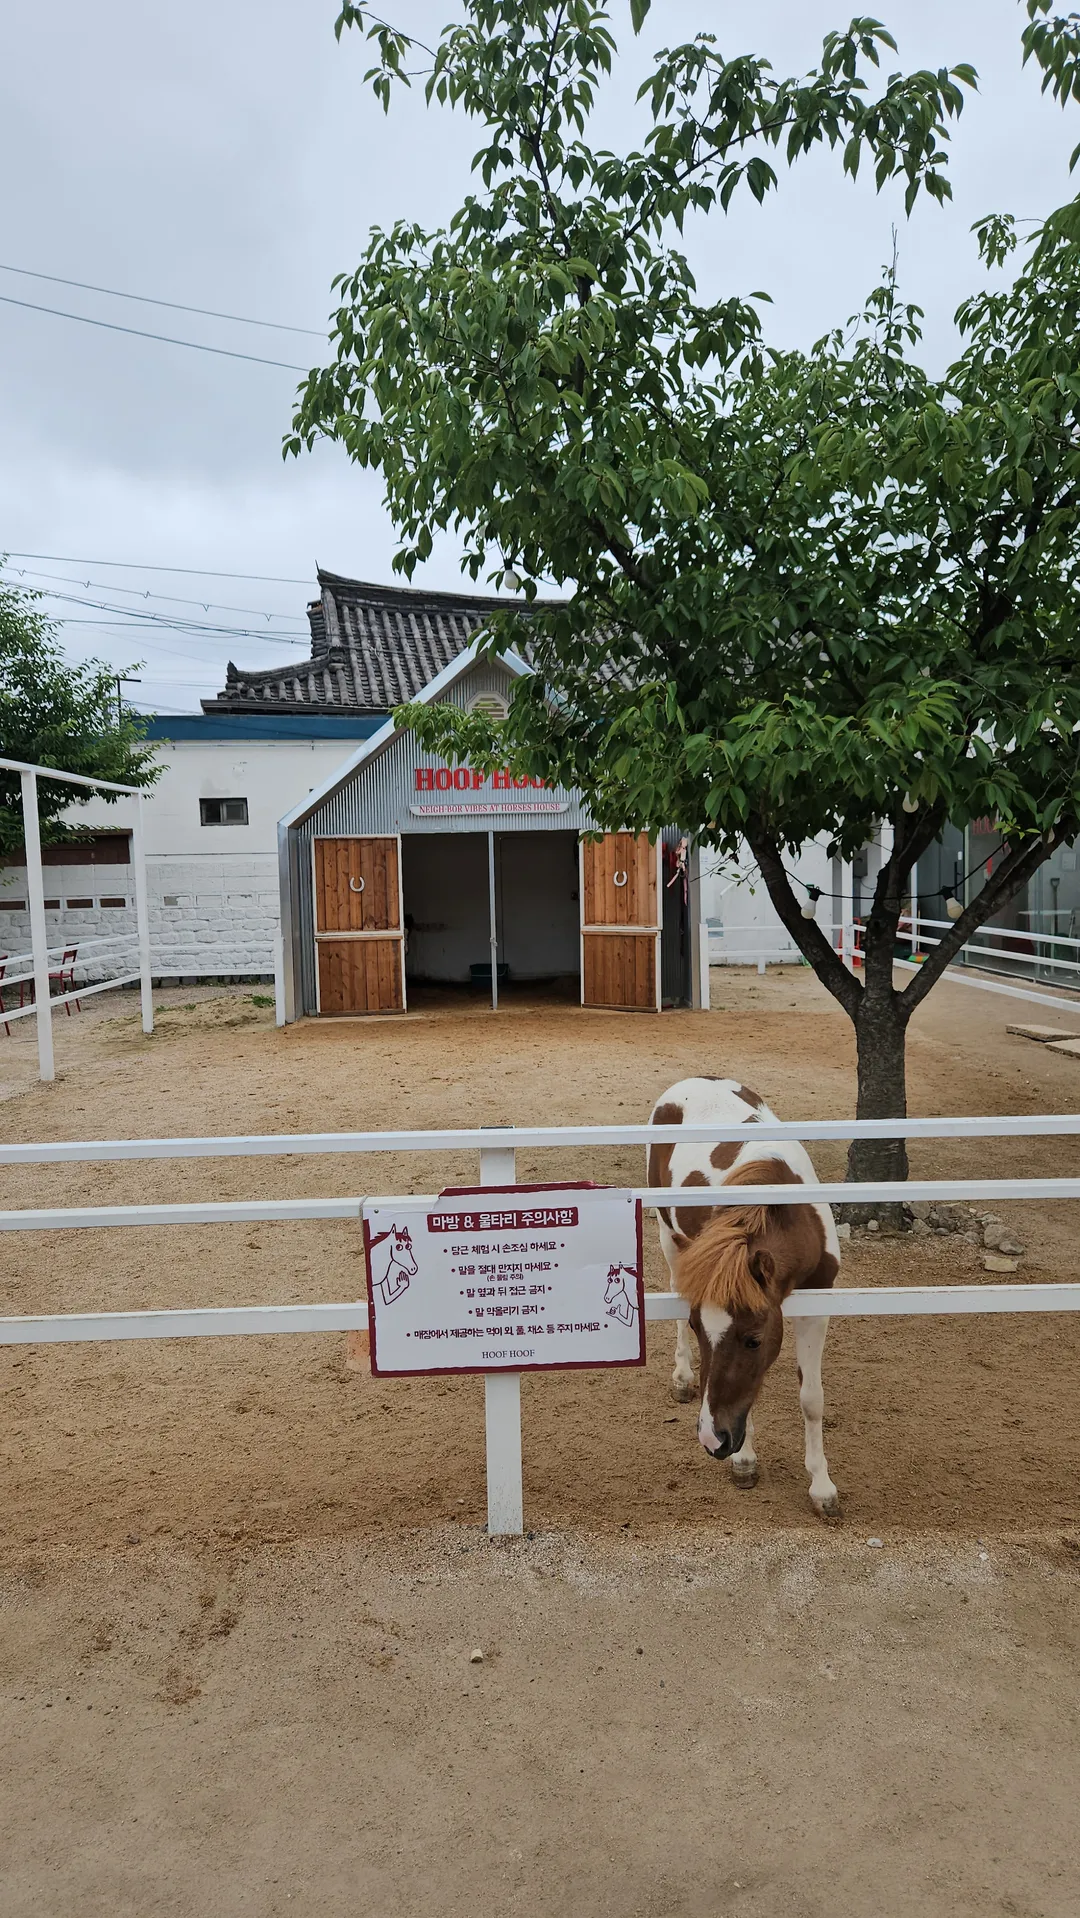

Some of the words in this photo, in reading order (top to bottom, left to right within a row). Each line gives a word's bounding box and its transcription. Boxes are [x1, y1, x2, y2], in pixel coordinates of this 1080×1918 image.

[464, 804, 488, 813] VIBES
[489, 803, 500, 812] AT
[501, 803, 532, 812] HORSES
[532, 802, 561, 811] HOUSE
[432, 1215, 460, 1230] 마방
[463, 1215, 475, 1228] &
[478, 1213, 517, 1228] 울타리
[520, 1209, 574, 1226] 주의사항
[451, 1245, 469, 1256] 당근
[471, 1244, 490, 1255] 체험
[491, 1243, 500, 1254] 시
[501, 1242, 528, 1253] 손조심
[530, 1241, 557, 1251] 하세요
[458, 1265, 475, 1275] 말을
[477, 1264, 496, 1275] 절대
[498, 1262, 523, 1273] 만지지
[524, 1261, 552, 1272] 마세요
[466, 1288, 475, 1298] 말
[477, 1287, 496, 1298] 옆과
[497, 1286, 507, 1297] 뒤
[508, 1285, 527, 1296] 접근
[528, 1284, 546, 1295] 금지
[475, 1307, 484, 1317] 말
[486, 1306, 519, 1317] 약올리기
[521, 1305, 538, 1315] 금지
[414, 1328, 449, 1340] 매장에서
[450, 1327, 484, 1339] 제공하는
[486, 1326, 503, 1336] 먹이
[527, 1325, 545, 1335] 채소
[546, 1324, 555, 1334] 등
[556, 1323, 573, 1333] 주지
[574, 1322, 601, 1333] 마세요
[481, 1350, 508, 1359] HOOF
[509, 1349, 536, 1358] HOOF
